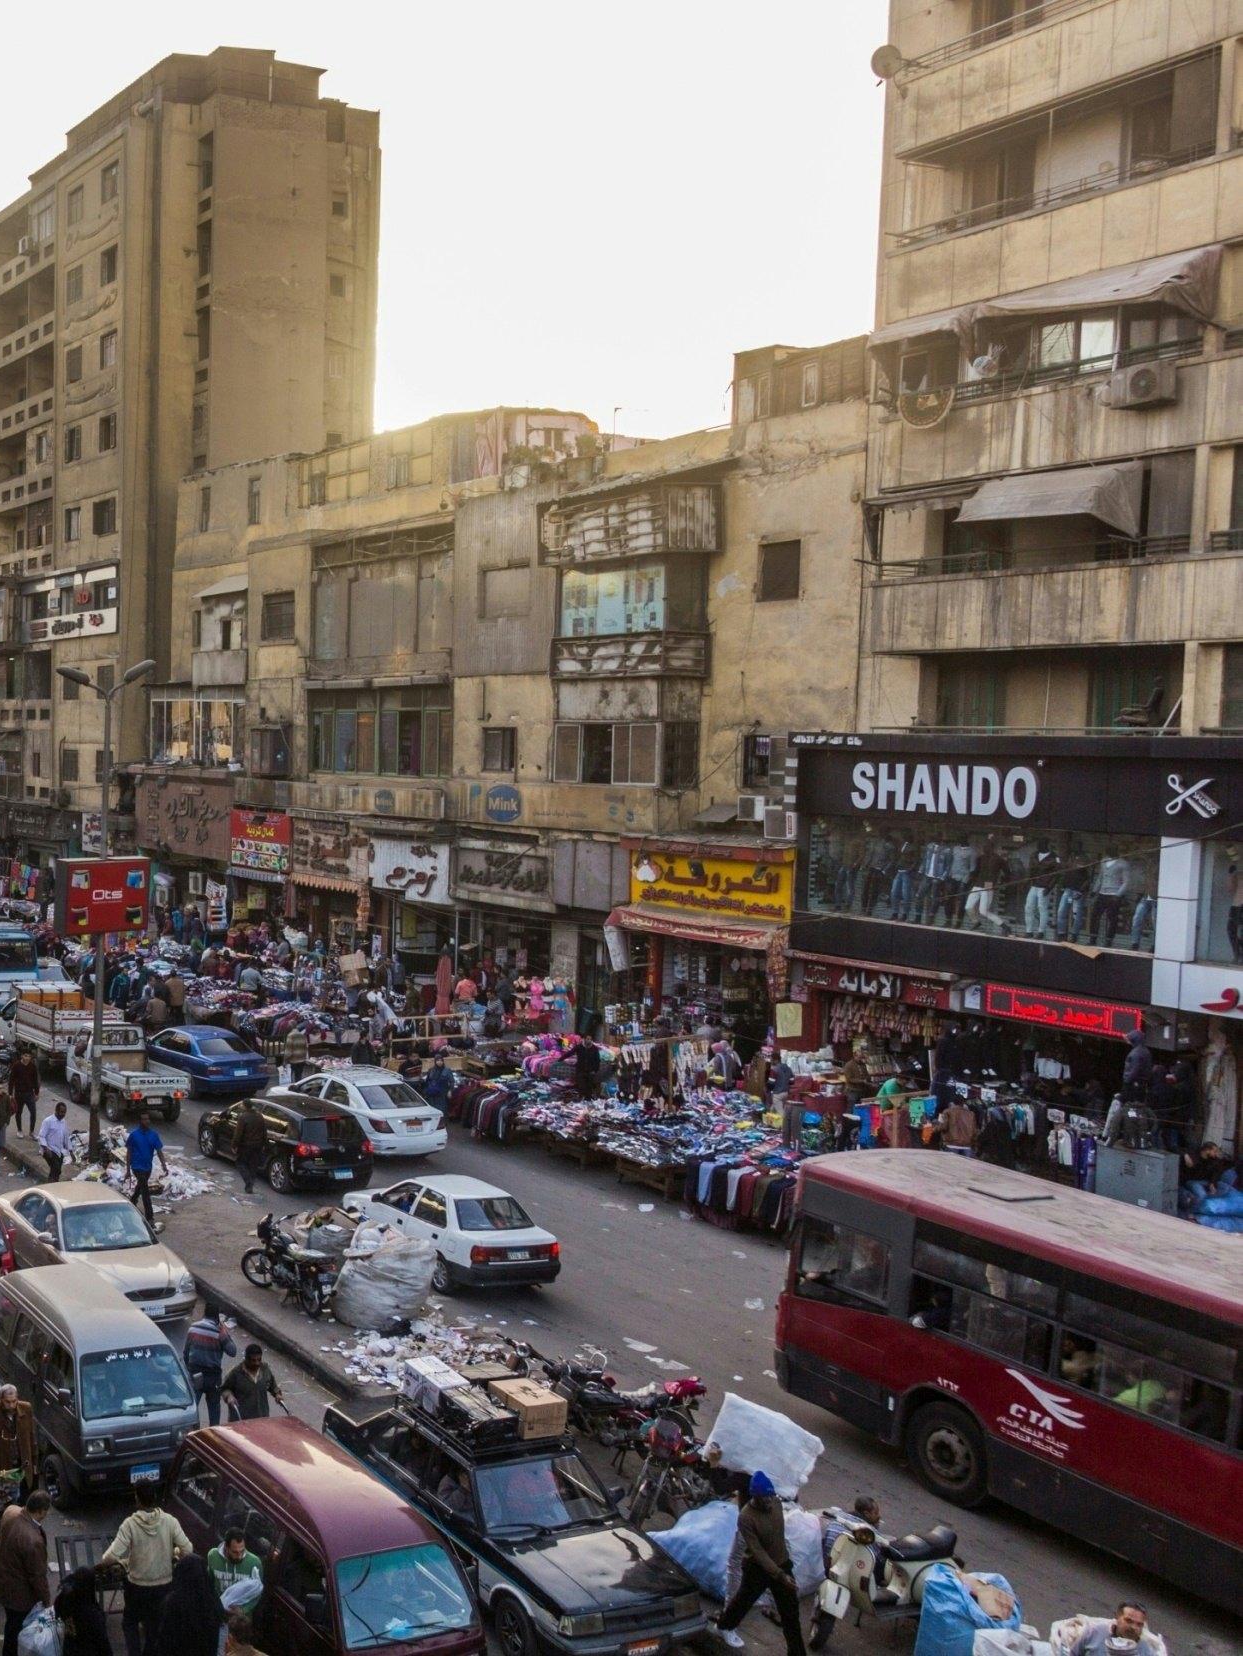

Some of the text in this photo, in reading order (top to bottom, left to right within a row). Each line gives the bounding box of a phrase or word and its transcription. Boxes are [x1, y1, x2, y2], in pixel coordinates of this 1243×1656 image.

[488, 797, 518, 812] Mink
[851, 761, 1037, 819] SHANDO
[385, 865, 439, 898] زمزم
[1009, 1403, 1054, 1432] CTA
